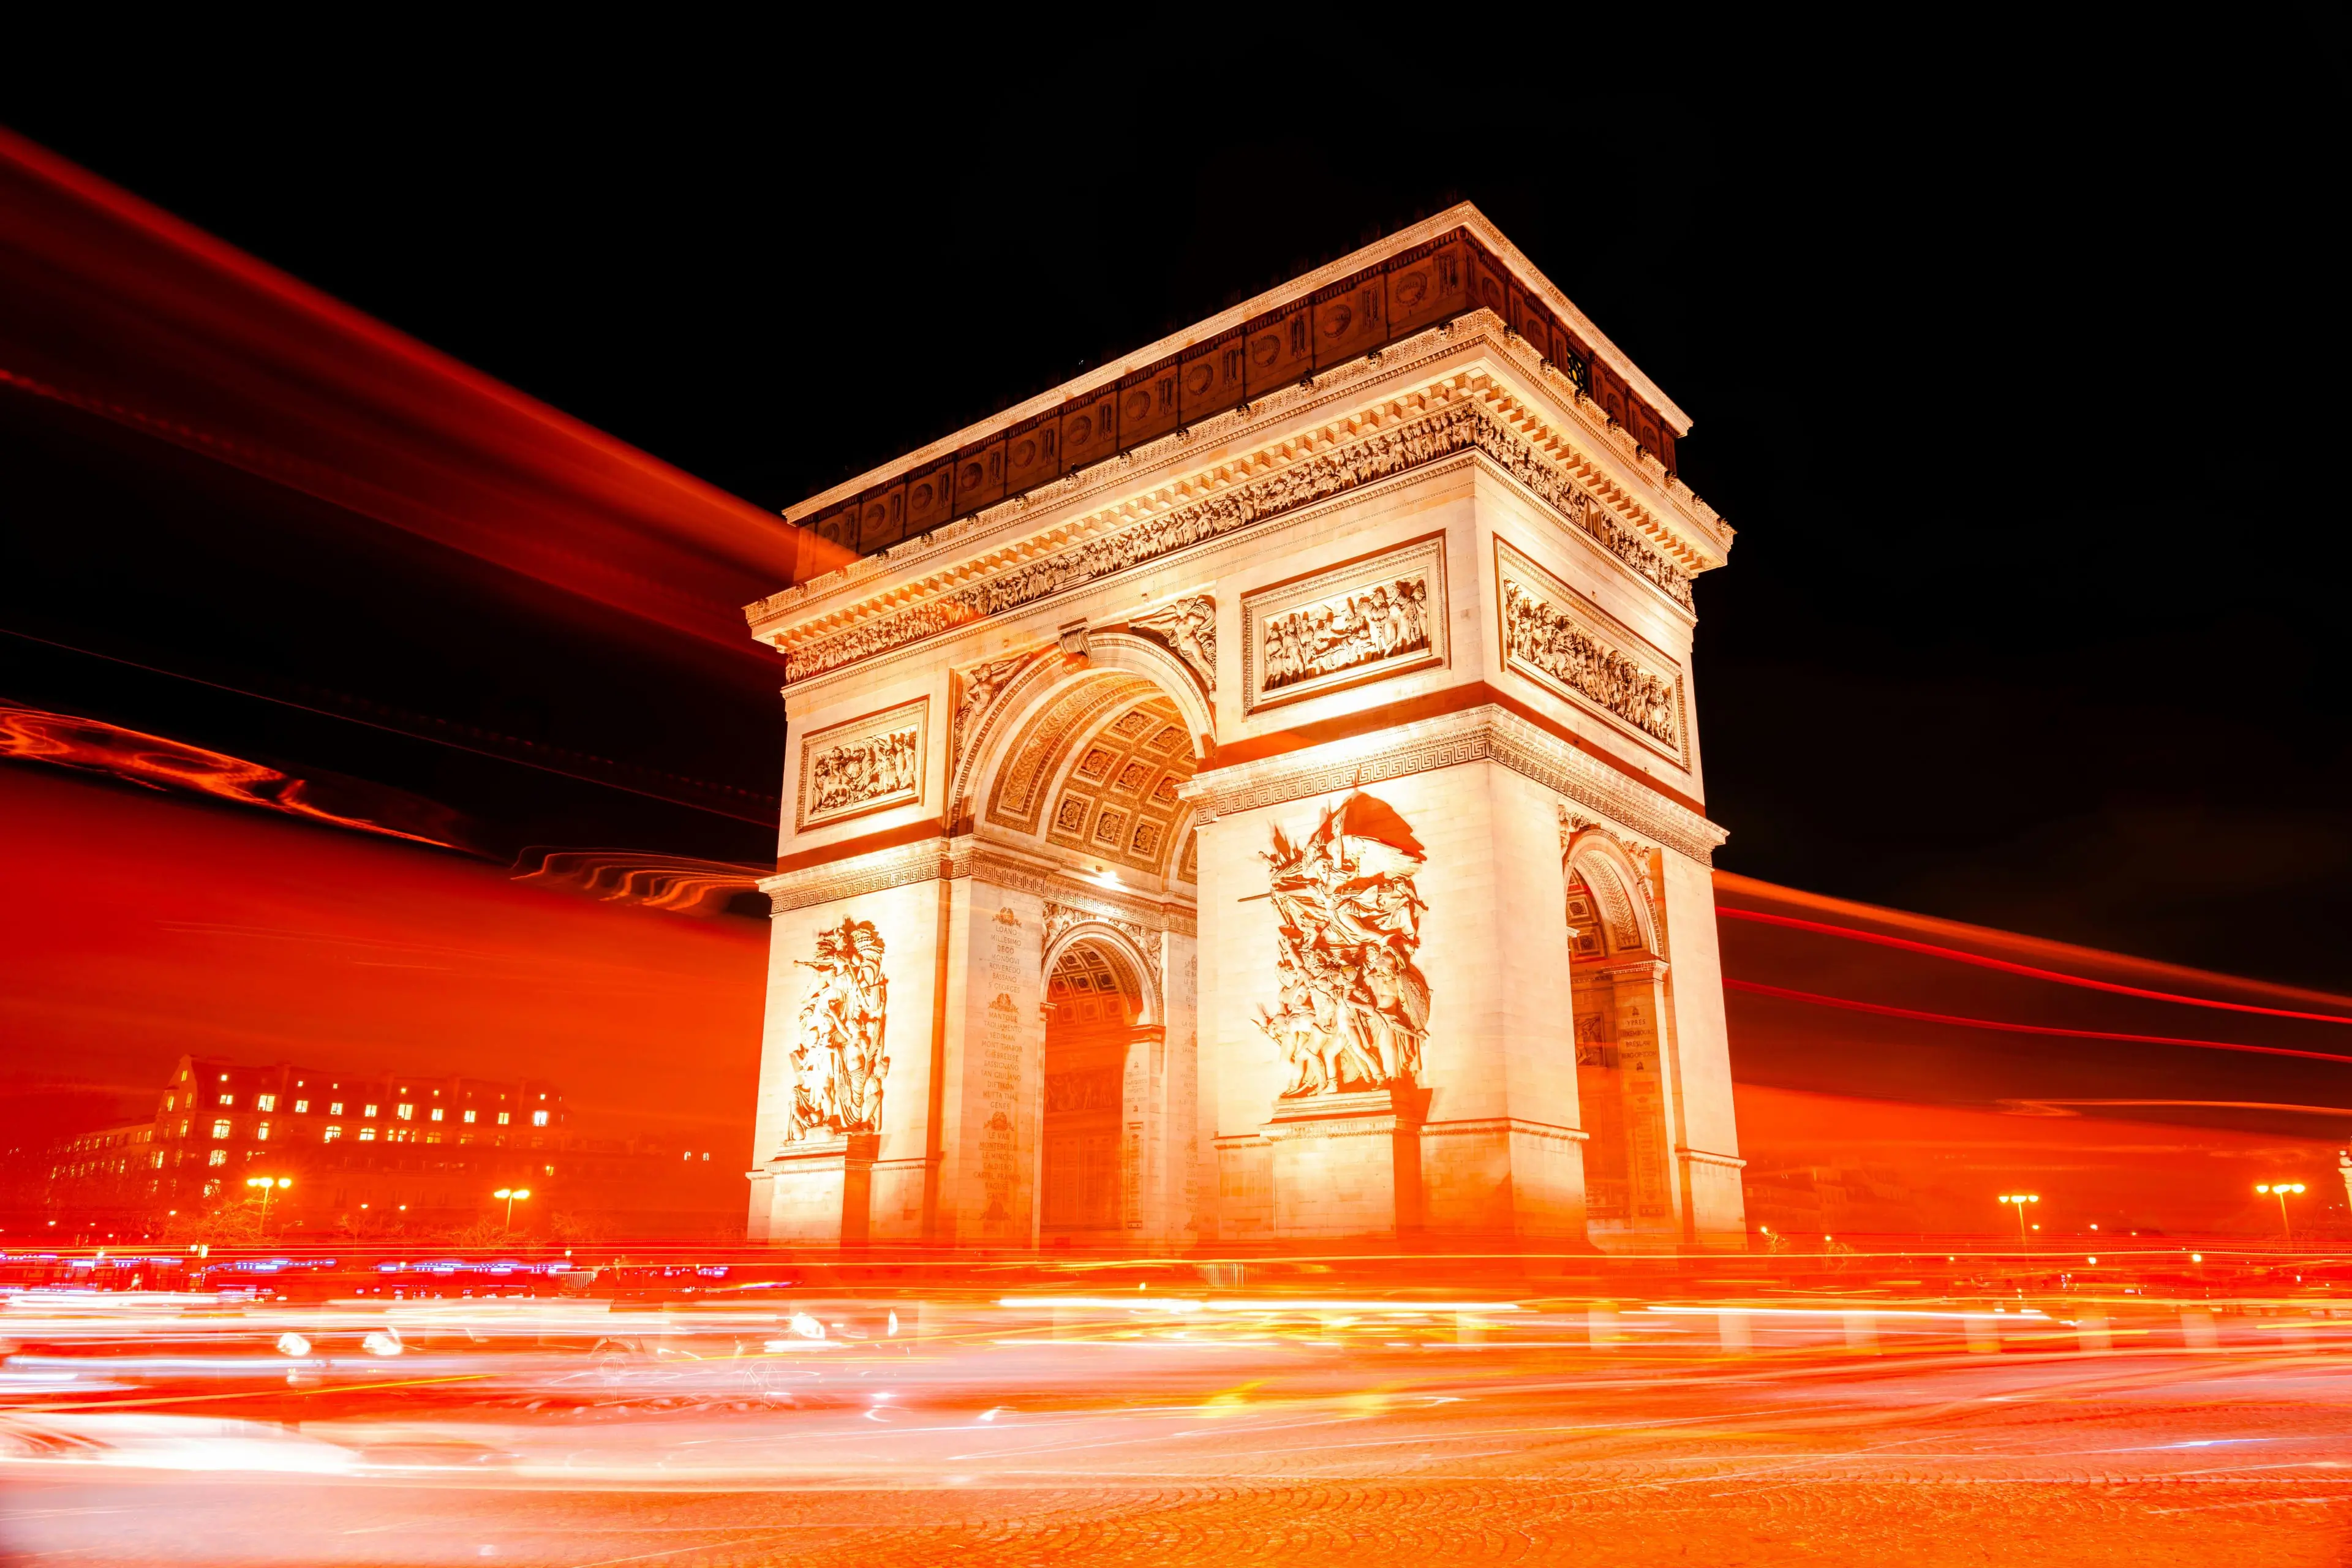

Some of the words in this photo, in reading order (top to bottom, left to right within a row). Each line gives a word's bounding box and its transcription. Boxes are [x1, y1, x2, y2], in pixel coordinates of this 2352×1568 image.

[996, 925, 1017, 936] LOANO
[990, 934, 1021, 946] MILLESIMO
[992, 954, 1020, 965] MONDOVI
[989, 962, 1021, 974] ROVEREDO
[992, 972, 1017, 983] BASSANO
[994, 982, 1020, 993] GEORGES
[989, 1011, 1018, 1023] MANTOUE
[984, 1020, 1022, 1033] TAGLIAMENTO
[990, 1031, 1016, 1042] SEDIMAN
